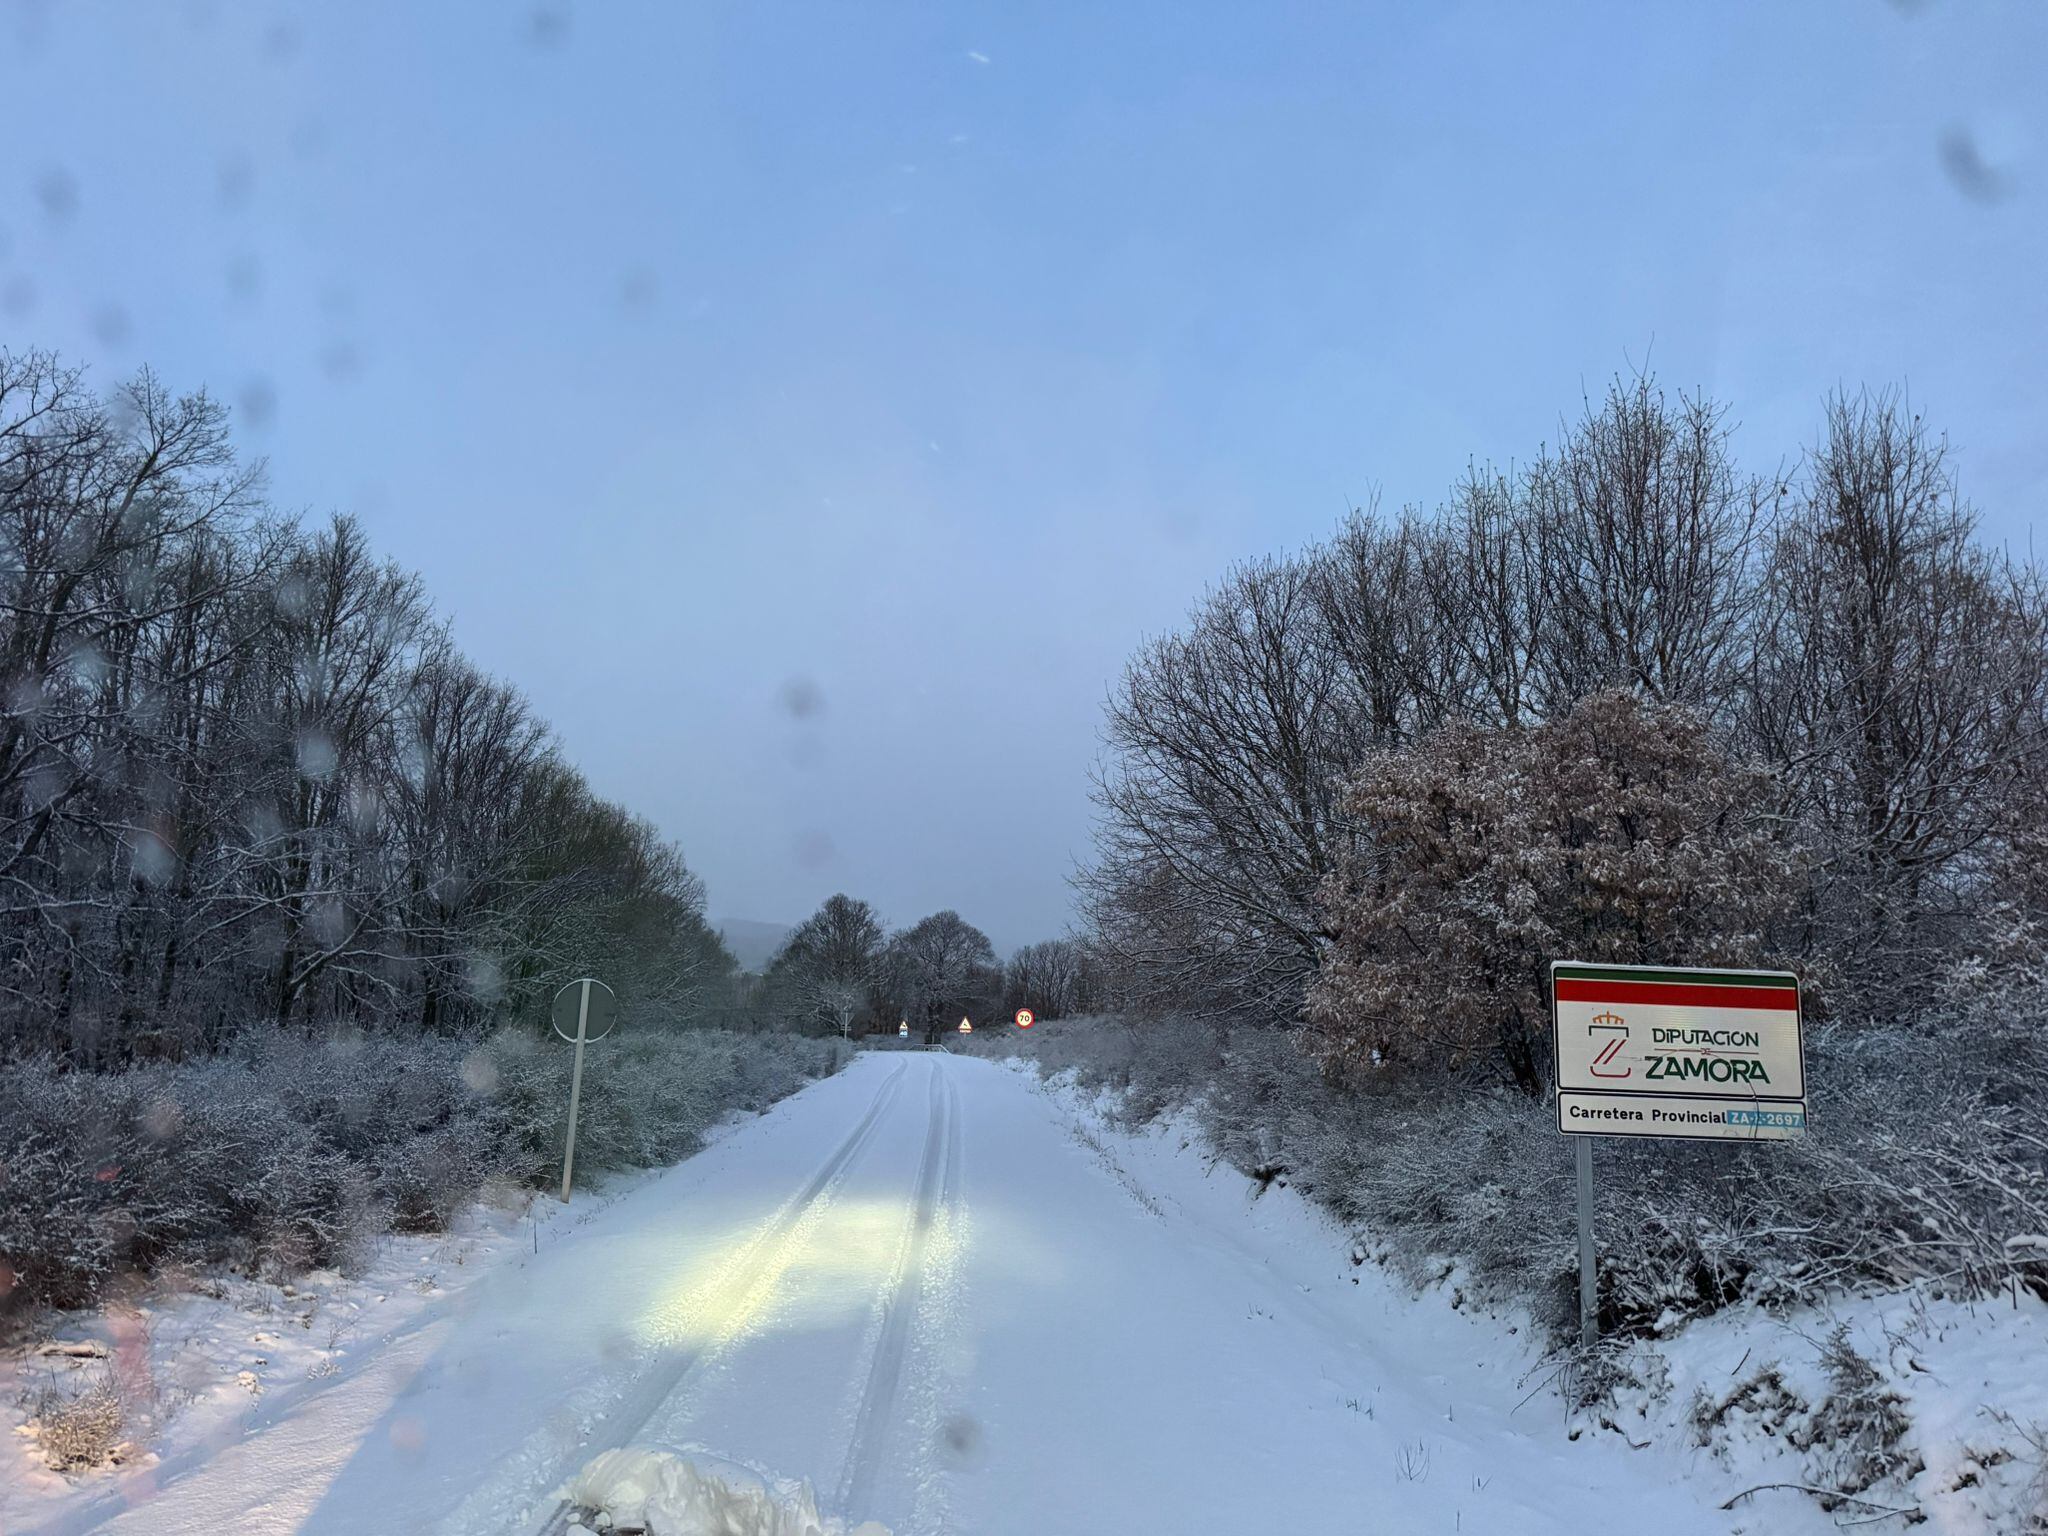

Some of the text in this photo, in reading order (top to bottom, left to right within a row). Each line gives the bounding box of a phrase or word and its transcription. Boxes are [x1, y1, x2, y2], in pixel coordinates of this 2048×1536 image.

[1644, 1055, 1771, 1084] ZAMORA
[1569, 1105, 1644, 1121] Carretera
[1652, 1109, 1727, 1124] Provincial
